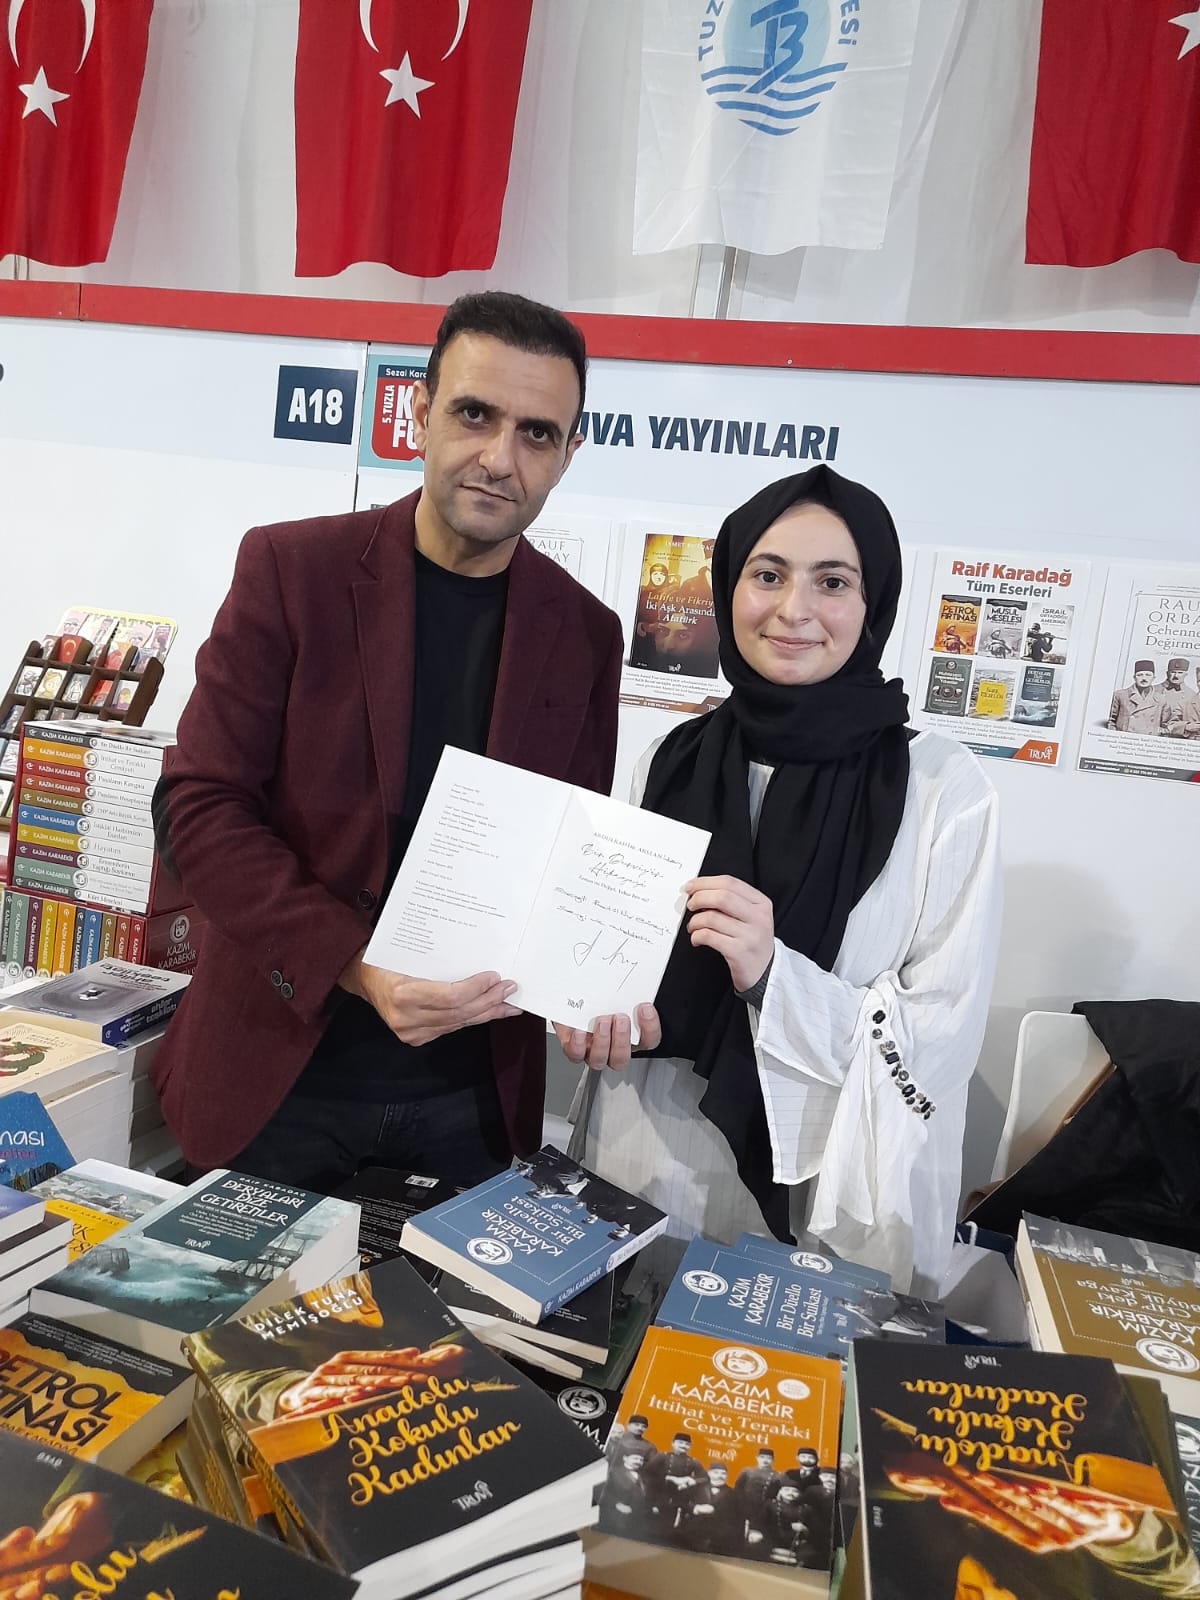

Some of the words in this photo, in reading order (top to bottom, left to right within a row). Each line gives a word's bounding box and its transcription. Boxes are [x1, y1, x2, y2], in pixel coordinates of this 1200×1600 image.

[385, 367, 407, 377] Sezai
[287, 387, 344, 426] A18
[648, 415, 840, 462] YAYINLARI
[951, 560, 990, 578] Raif
[992, 563, 1073, 588] Karadağ
[966, 580, 996, 594] Tüm
[999, 582, 1053, 599] Eserleri
[646, 600, 658, 610] İki
[659, 603, 676, 614] Aşk
[942, 605, 977, 616] PETROL
[166, 941, 191, 958] KAZIM
[200, 1193, 289, 1226] GETİRENLER
[221, 1180, 306, 1209] DERYALARI
[503, 1202, 550, 1233] Düello
[511, 1195, 564, 1228] Suikast
[481, 1208, 564, 1257] KARABEKİR
[486, 1223, 537, 1255] KAZIM
[550, 1230, 575, 1245] Bir
[562, 1225, 587, 1240] Bir
[558, 1287, 575, 1304] KAZIM
[727, 1277, 753, 1309] KAZIM
[744, 1272, 776, 1326] KARABEKİR
[780, 1283, 803, 1315] Düello
[800, 1287, 823, 1322] Suikast
[1076, 1279, 1136, 1299] Kavga
[254, 1304, 307, 1333] DİLEK
[309, 1287, 358, 1310] TUNA
[260, 1295, 365, 1341] MEMİŞOĞLU
[775, 1316, 794, 1331] Bir
[1088, 1302, 1200, 1335] ARABEKİR
[797, 1322, 816, 1339] Bir
[1118, 1319, 1196, 1346] KAZIM
[671, 1382, 795, 1420] KARABEKİR
[699, 1374, 770, 1400] KAZIM
[900, 1378, 1088, 1421] Kadınlar
[319, 1375, 471, 1443] Anadolu
[348, 1404, 480, 1467] Kokulu
[682, 1417, 770, 1446] Cemiyeti
[710, 1412, 733, 1425] ve
[737, 1415, 811, 1441] Terakki
[926, 1406, 1075, 1450] Kokulu
[346, 1421, 521, 1506] Kadınlar
[912, 1431, 1093, 1485] Anadolu
